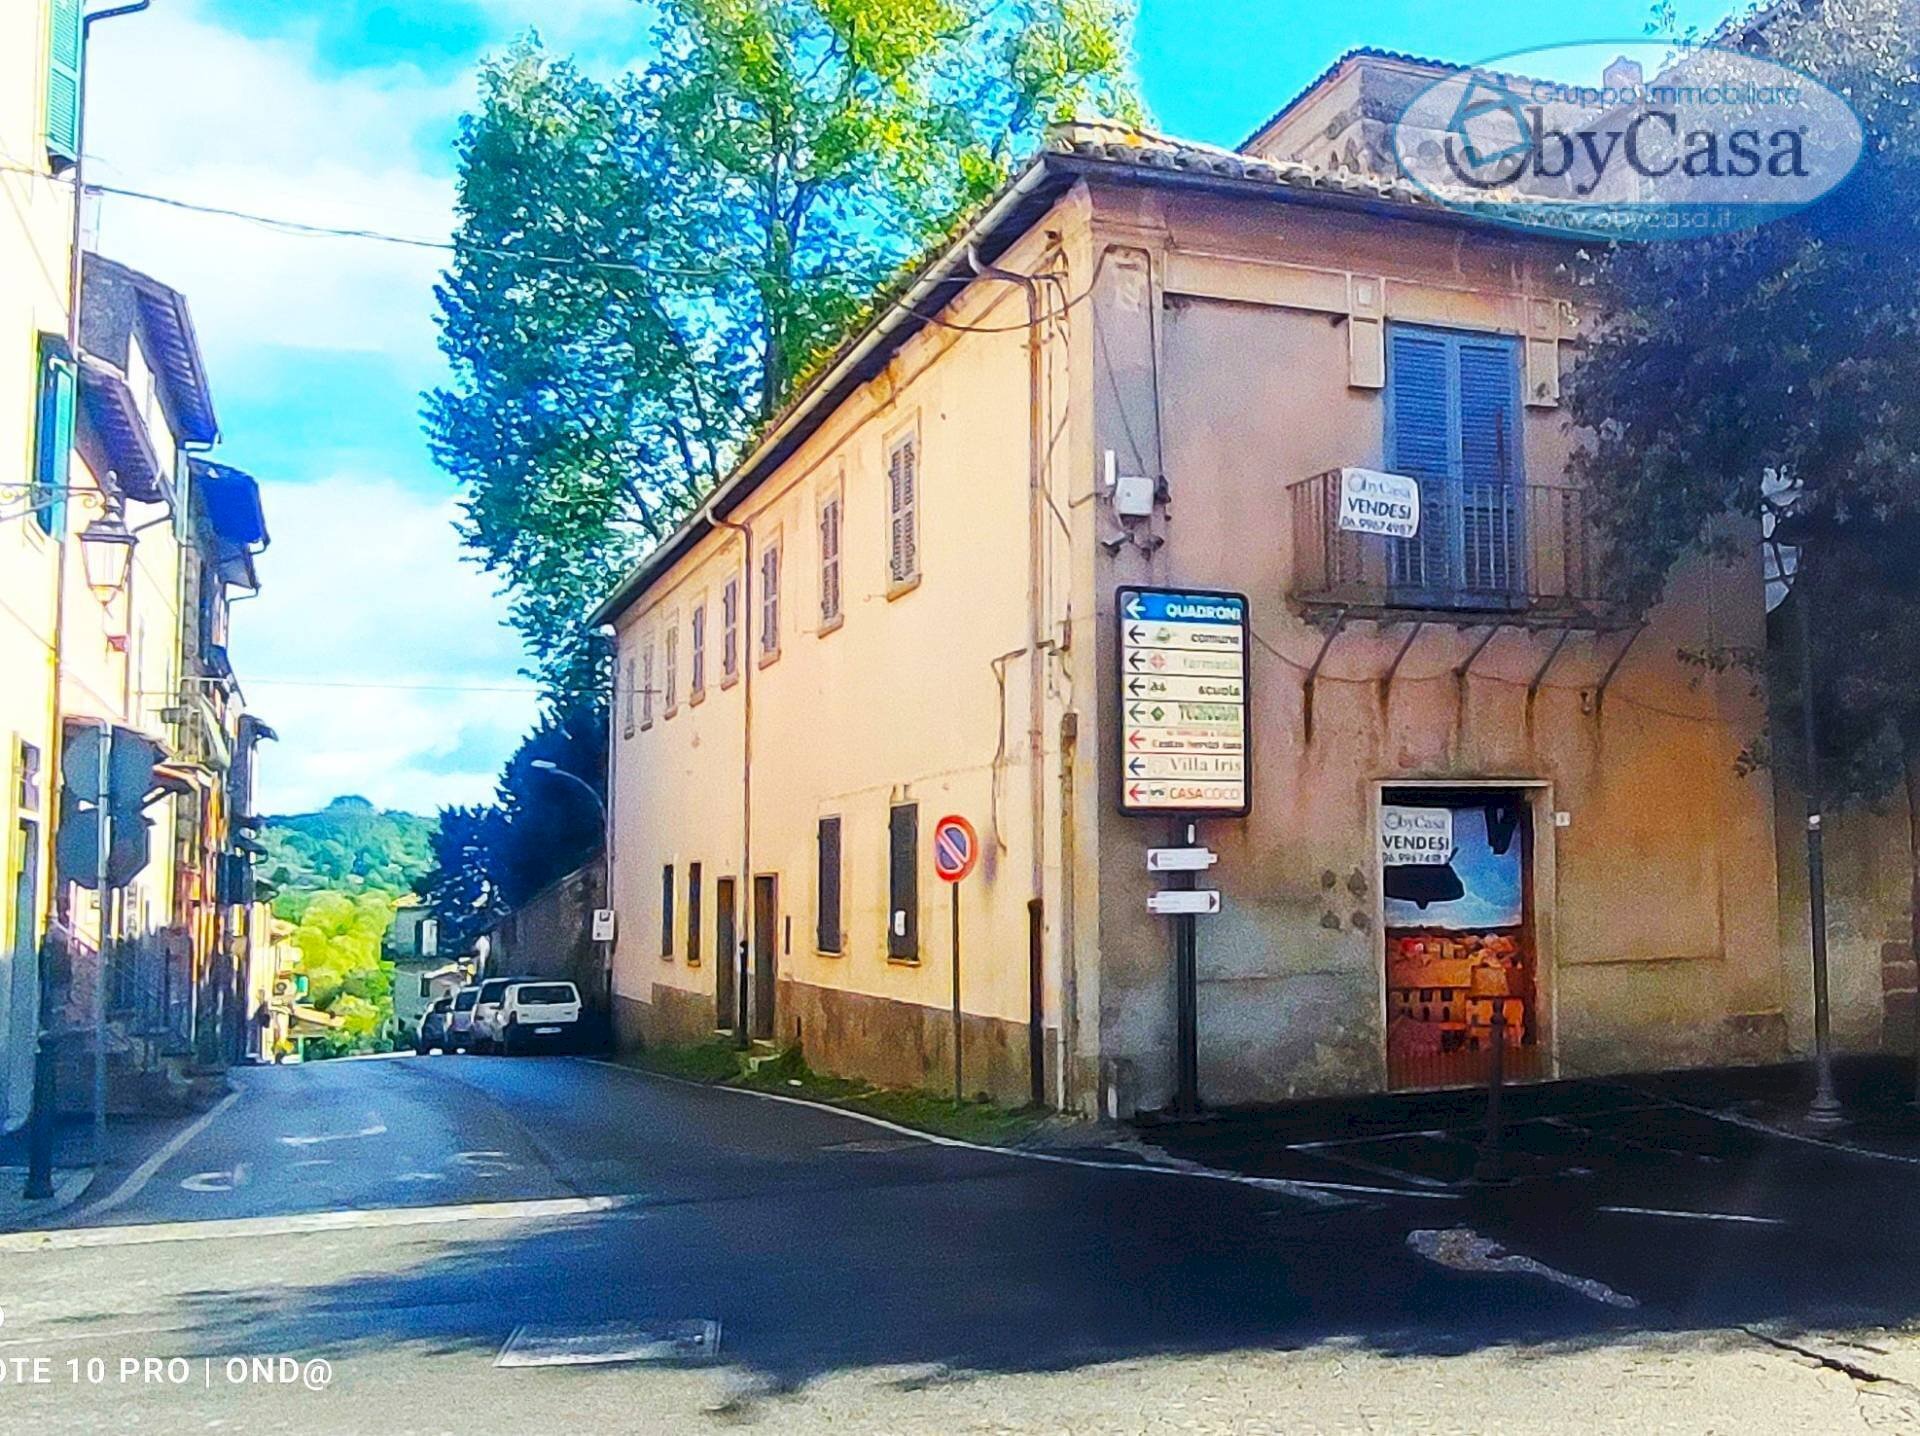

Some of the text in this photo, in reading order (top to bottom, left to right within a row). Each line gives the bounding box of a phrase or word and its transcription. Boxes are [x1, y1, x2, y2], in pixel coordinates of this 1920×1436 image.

[1348, 496, 1411, 520] VENDESI
[1166, 603, 1241, 620] QUADRONI
[1198, 685, 1241, 697] scuola
[1169, 757, 1241, 772] Villa Iris
[1382, 835, 1449, 851] VENDESI
